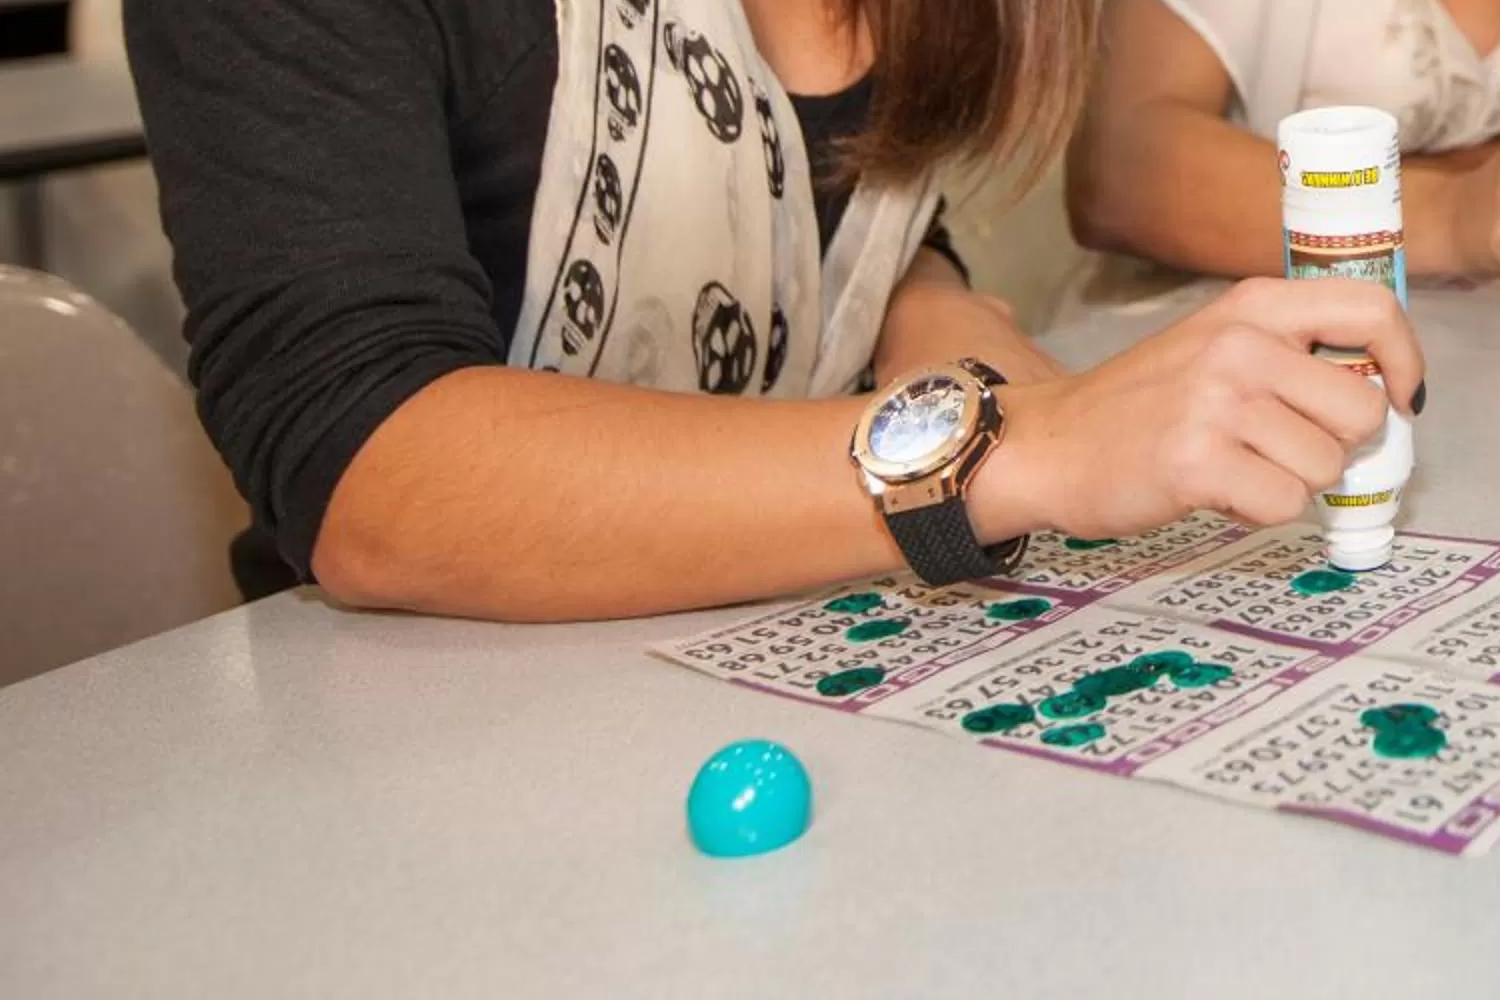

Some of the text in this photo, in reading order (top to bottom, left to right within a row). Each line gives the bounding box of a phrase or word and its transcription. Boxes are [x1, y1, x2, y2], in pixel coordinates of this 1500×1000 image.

[1445, 554, 1472, 563] 5
[1409, 569, 1451, 587] 20
[1158, 588, 1205, 607] 72
[1378, 586, 1420, 601] 35
[1195, 596, 1242, 615] 75
[1238, 605, 1275, 625] 67
[1271, 614, 1314, 633] 63
[1310, 621, 1353, 639] 66
[685, 644, 733, 661] 63
[912, 637, 962, 654] 36
[1427, 638, 1469, 657] 65
[718, 653, 766, 672] 68
[925, 621, 1142, 720] 13 21 36 57 63
